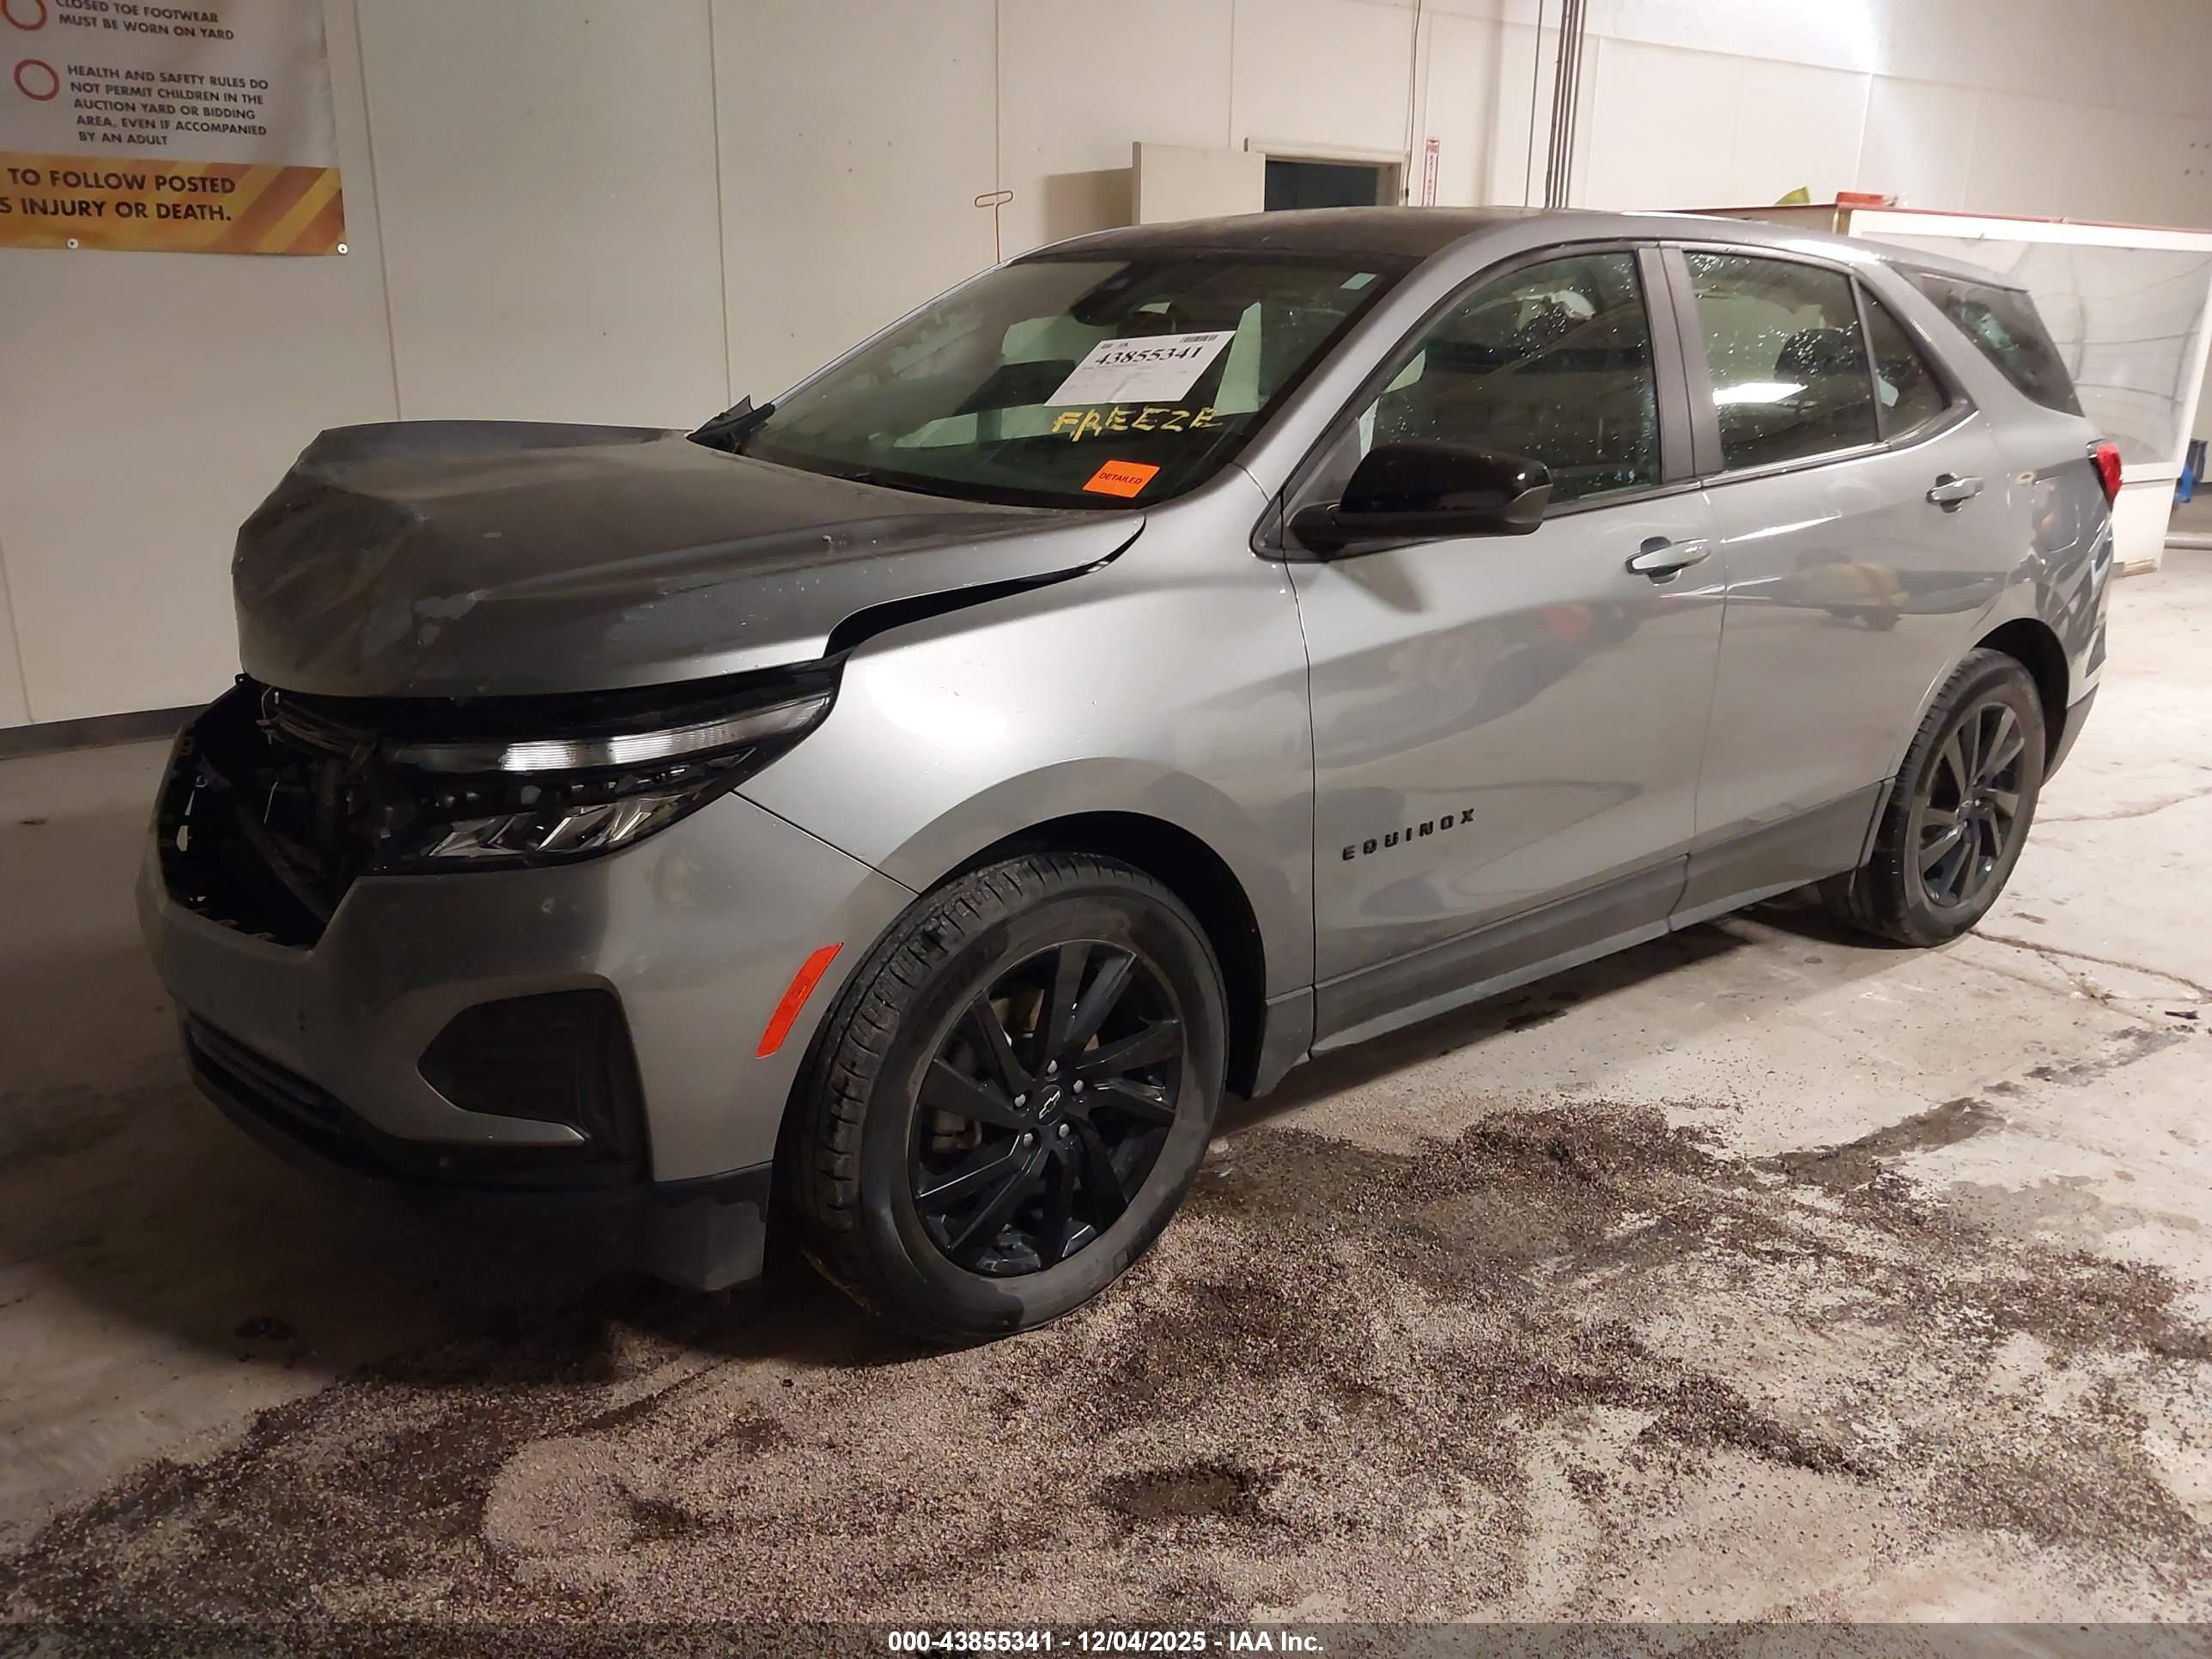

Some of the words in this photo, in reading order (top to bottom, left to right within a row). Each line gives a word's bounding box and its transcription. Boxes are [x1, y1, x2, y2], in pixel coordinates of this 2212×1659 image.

[114, 3, 138, 15] TOE
[143, 6, 219, 22] FOOTWEAR
[58, 14, 98, 27] MUST
[103, 17, 119, 29] BE
[124, 21, 169, 35] WORN
[173, 26, 195, 37] ON
[199, 27, 234, 40] YARD
[68, 64, 120, 80] HEALTH
[125, 69, 155, 82] AND
[159, 72, 204, 86] SAFETY
[210, 76, 246, 88] RULES
[250, 78, 268, 89] DO
[70, 82, 100, 95] NOT
[106, 85, 152, 98] PERMIT
[157, 88, 219, 101] CHILDREN
[224, 92, 238, 102] IN
[242, 94, 263, 105] THE
[74, 99, 136, 112] AUCTION
[140, 103, 175, 114] YARD
[180, 105, 199, 116] OR
[203, 107, 255, 119] BIDDING
[76, 116, 116, 129] AREA,
[121, 118, 155, 130] EVEN
[160, 119, 170, 130] IF
[175, 121, 266, 136] ACCOMPANIED
[79, 131, 94, 142] BY
[101, 133, 122, 143] AN
[127, 134, 167, 145] ADULT
[8, 168, 41, 186] TO
[50, 171, 146, 191] FOLLOW
[155, 175, 235, 194] POSTED
[21, 198, 106, 217] INJURY
[114, 202, 149, 219] OR
[156, 203, 232, 222] DEATH.
[1096, 346, 1203, 365] 43855341
[1052, 406, 1224, 442] FREEZE
[1099, 471, 1142, 484] DETAILED
[1342, 808, 1474, 860] EQUINOX
